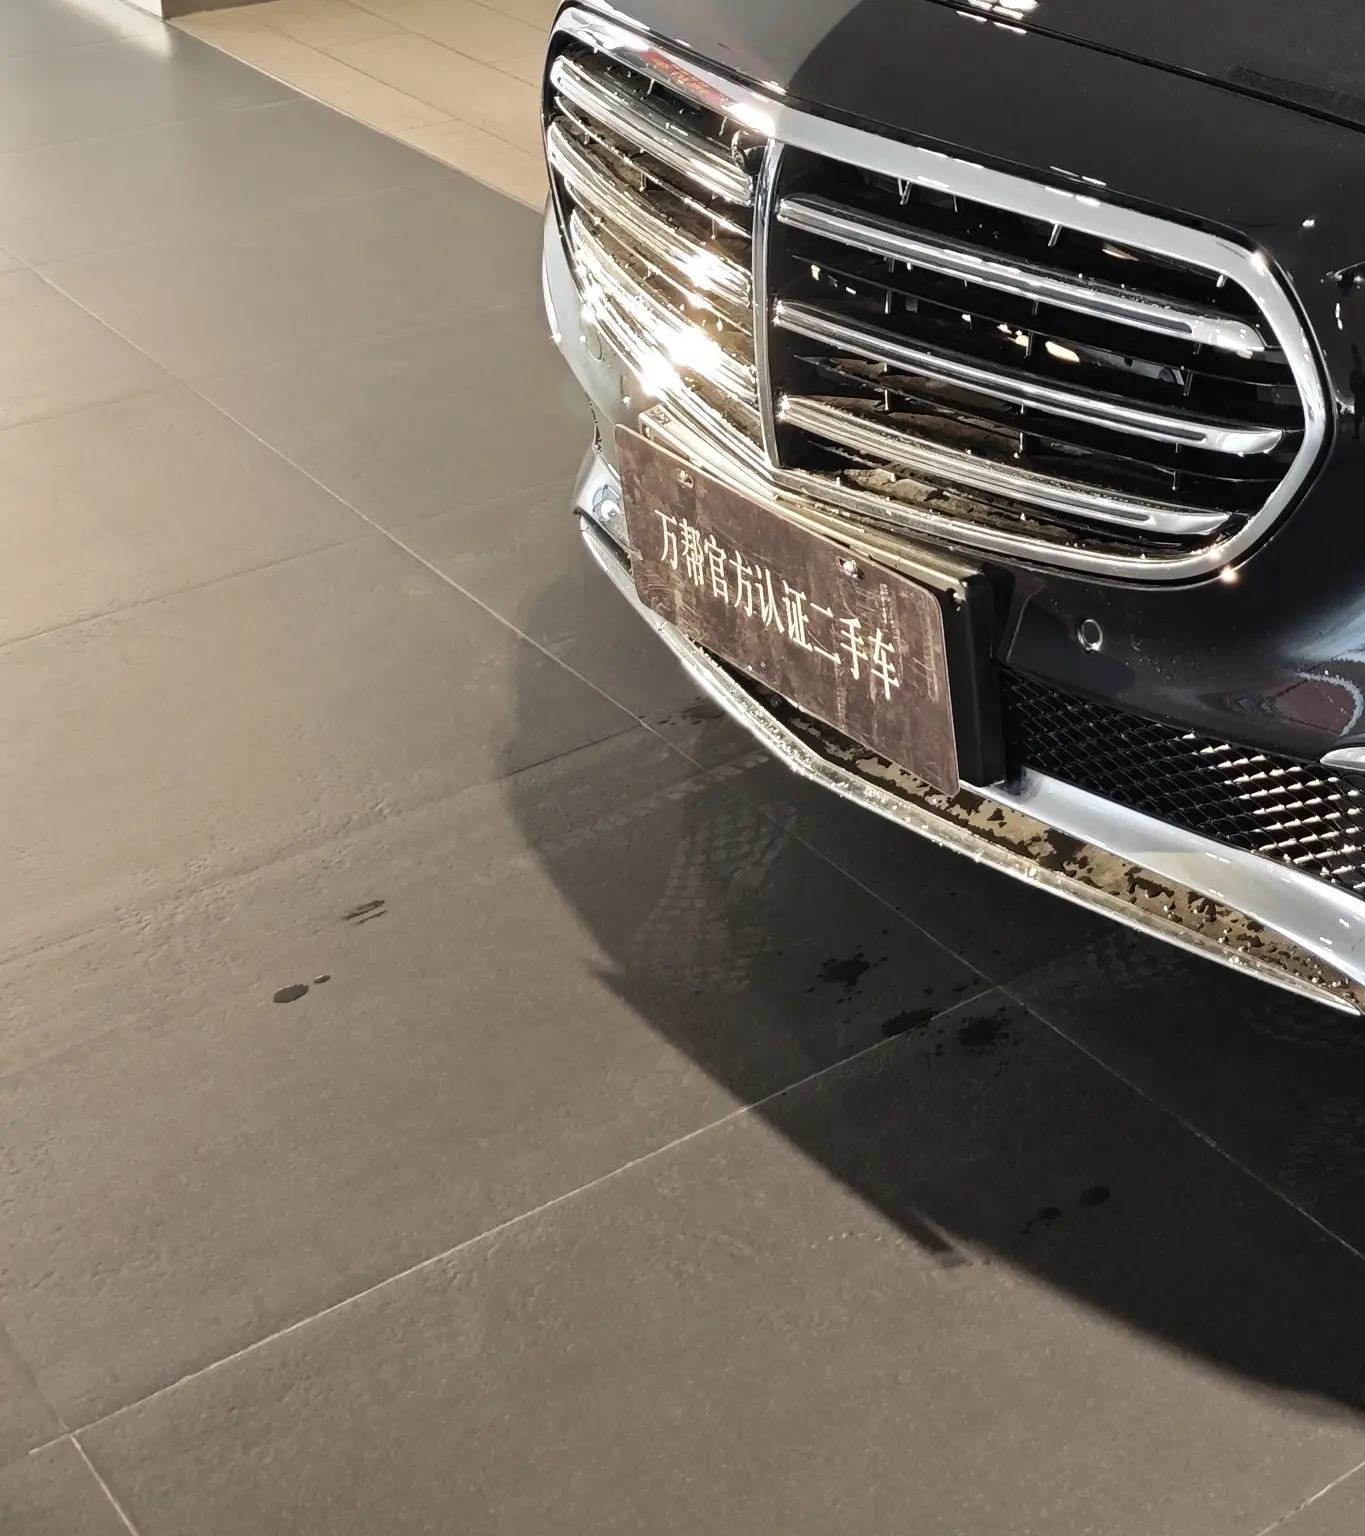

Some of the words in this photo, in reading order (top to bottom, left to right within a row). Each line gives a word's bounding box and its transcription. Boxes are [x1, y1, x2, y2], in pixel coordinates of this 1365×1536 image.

[654, 509, 901, 700] 万帮官方认证二手车
